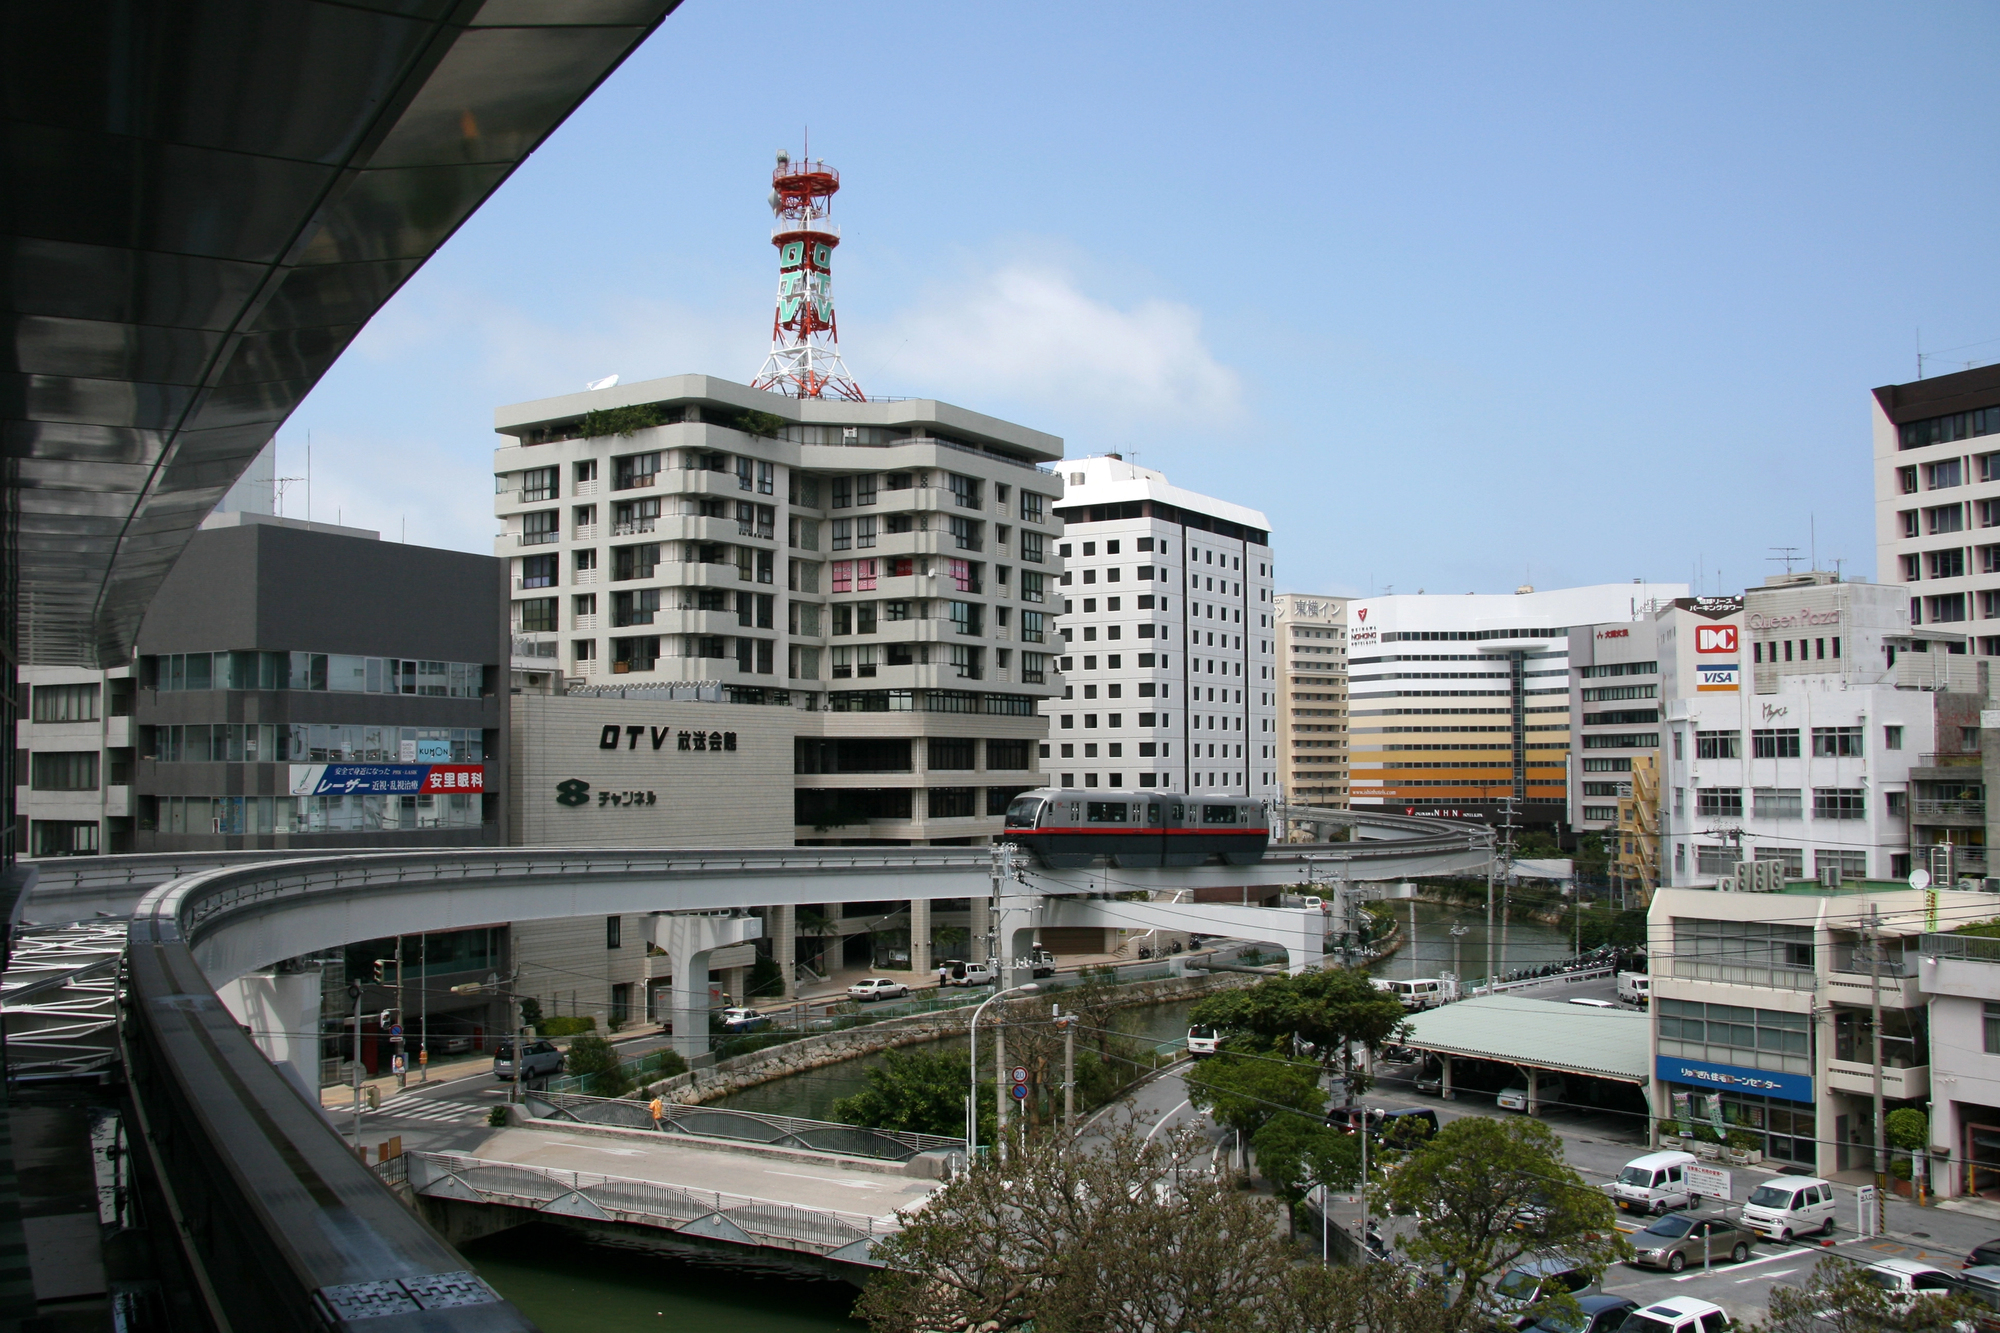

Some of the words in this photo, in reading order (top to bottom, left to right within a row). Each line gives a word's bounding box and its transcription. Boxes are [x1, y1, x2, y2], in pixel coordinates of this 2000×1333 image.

[780, 241, 804, 322] OTV
[813, 243, 833, 323] OTV
[1294, 599, 1341, 618] 東横イン
[1749, 613, 1799, 630] Queen
[1801, 607, 1840, 626] Plaza
[1700, 629, 1733, 650] DC
[1704, 672, 1732, 683] VISA
[599, 725, 669, 750] OTV
[677, 731, 737, 751] 放送会館
[419, 747, 448, 756] KUMON
[317, 778, 370, 793] レーザー
[430, 772, 483, 788] 安里眼科
[598, 790, 657, 807] チャンネル
[1015, 1071, 1025, 1079] 20
